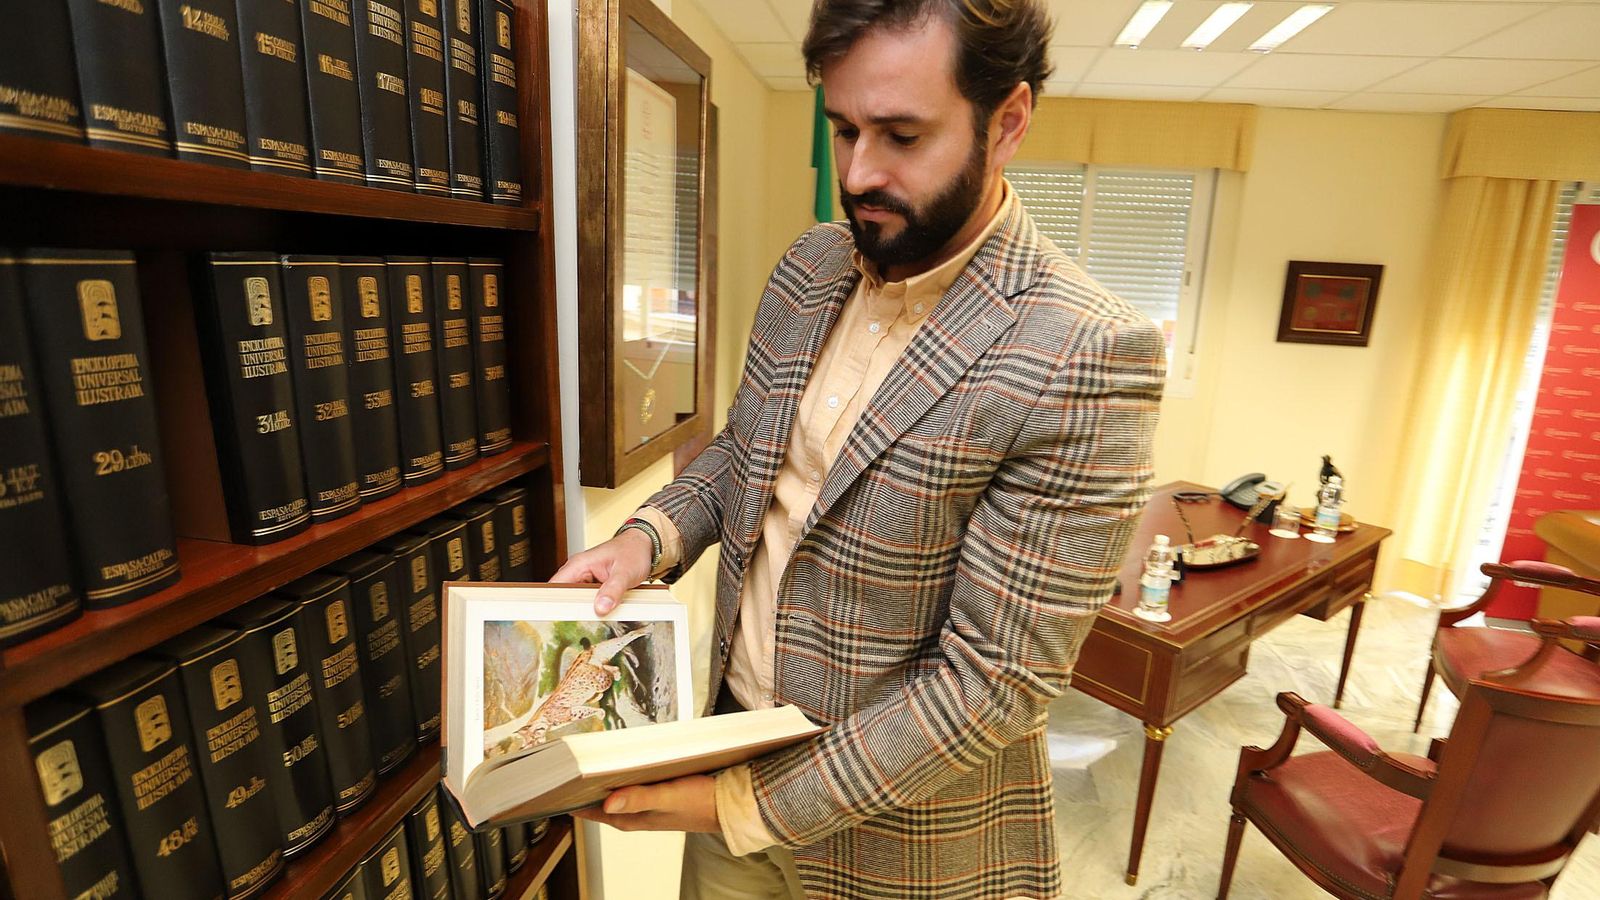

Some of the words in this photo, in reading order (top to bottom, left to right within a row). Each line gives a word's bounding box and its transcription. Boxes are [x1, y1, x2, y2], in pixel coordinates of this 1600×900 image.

[256, 32, 276, 55] 15
[318, 53, 334, 75] 16
[376, 72, 390, 90] 17
[420, 87, 434, 105] 18
[459, 99, 471, 116] 18
[240, 349, 287, 366] UNIVERSAL
[73, 367, 143, 389] UNIVERSAL
[363, 391, 380, 410] 33
[314, 403, 333, 422] 32
[256, 413, 275, 434] 31
[94, 449, 124, 475] 29
[283, 745, 302, 768] 50
[225, 786, 247, 808] 49
[156, 829, 184, 857] 48
